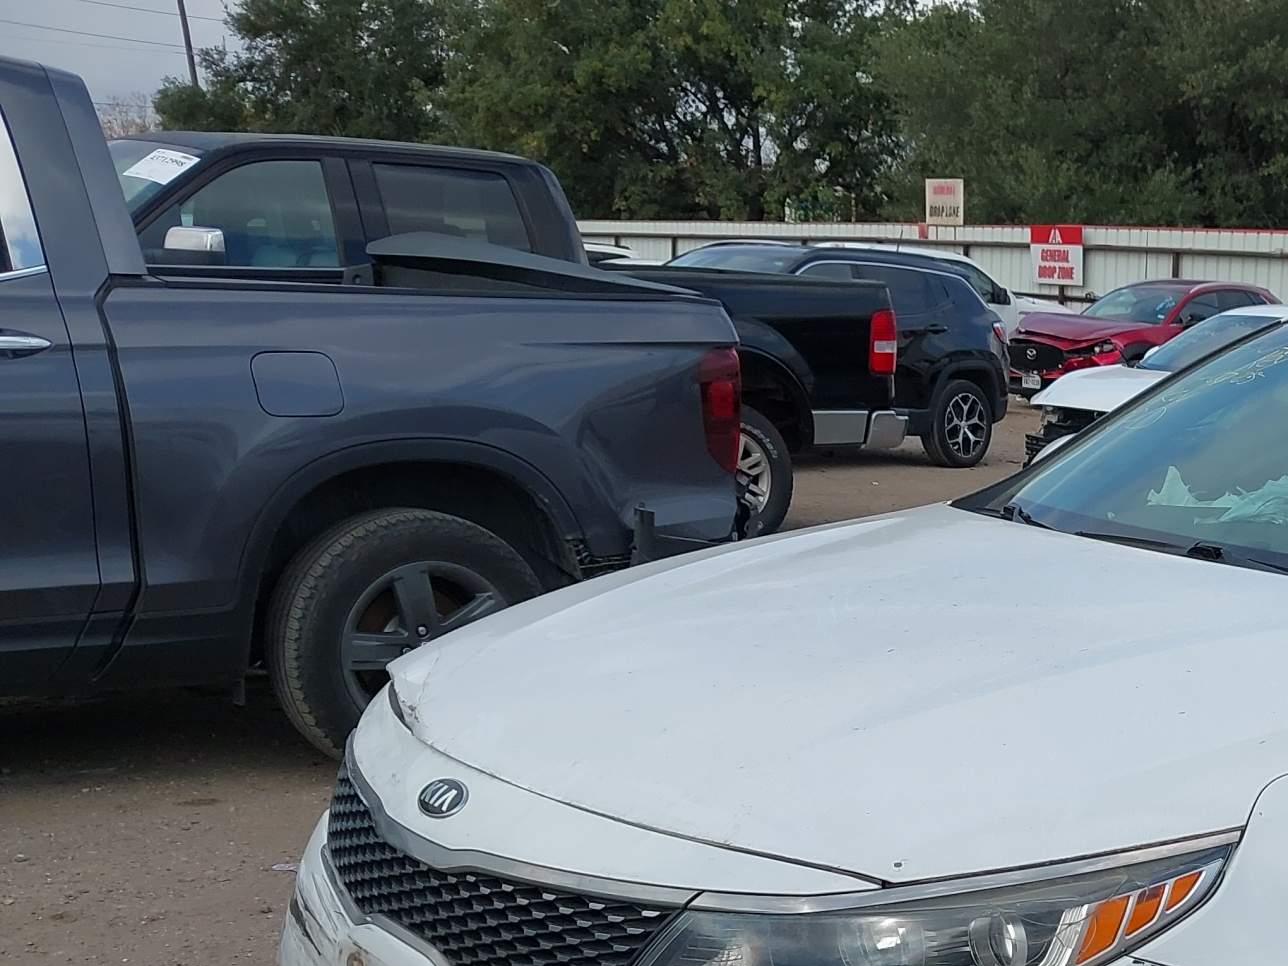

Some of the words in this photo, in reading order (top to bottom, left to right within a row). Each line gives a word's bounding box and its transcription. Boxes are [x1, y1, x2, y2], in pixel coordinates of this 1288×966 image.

[1041, 249, 1069, 263] GENERAL
[1038, 265, 1056, 279] DROP
[1057, 266, 1074, 280] ZONE
